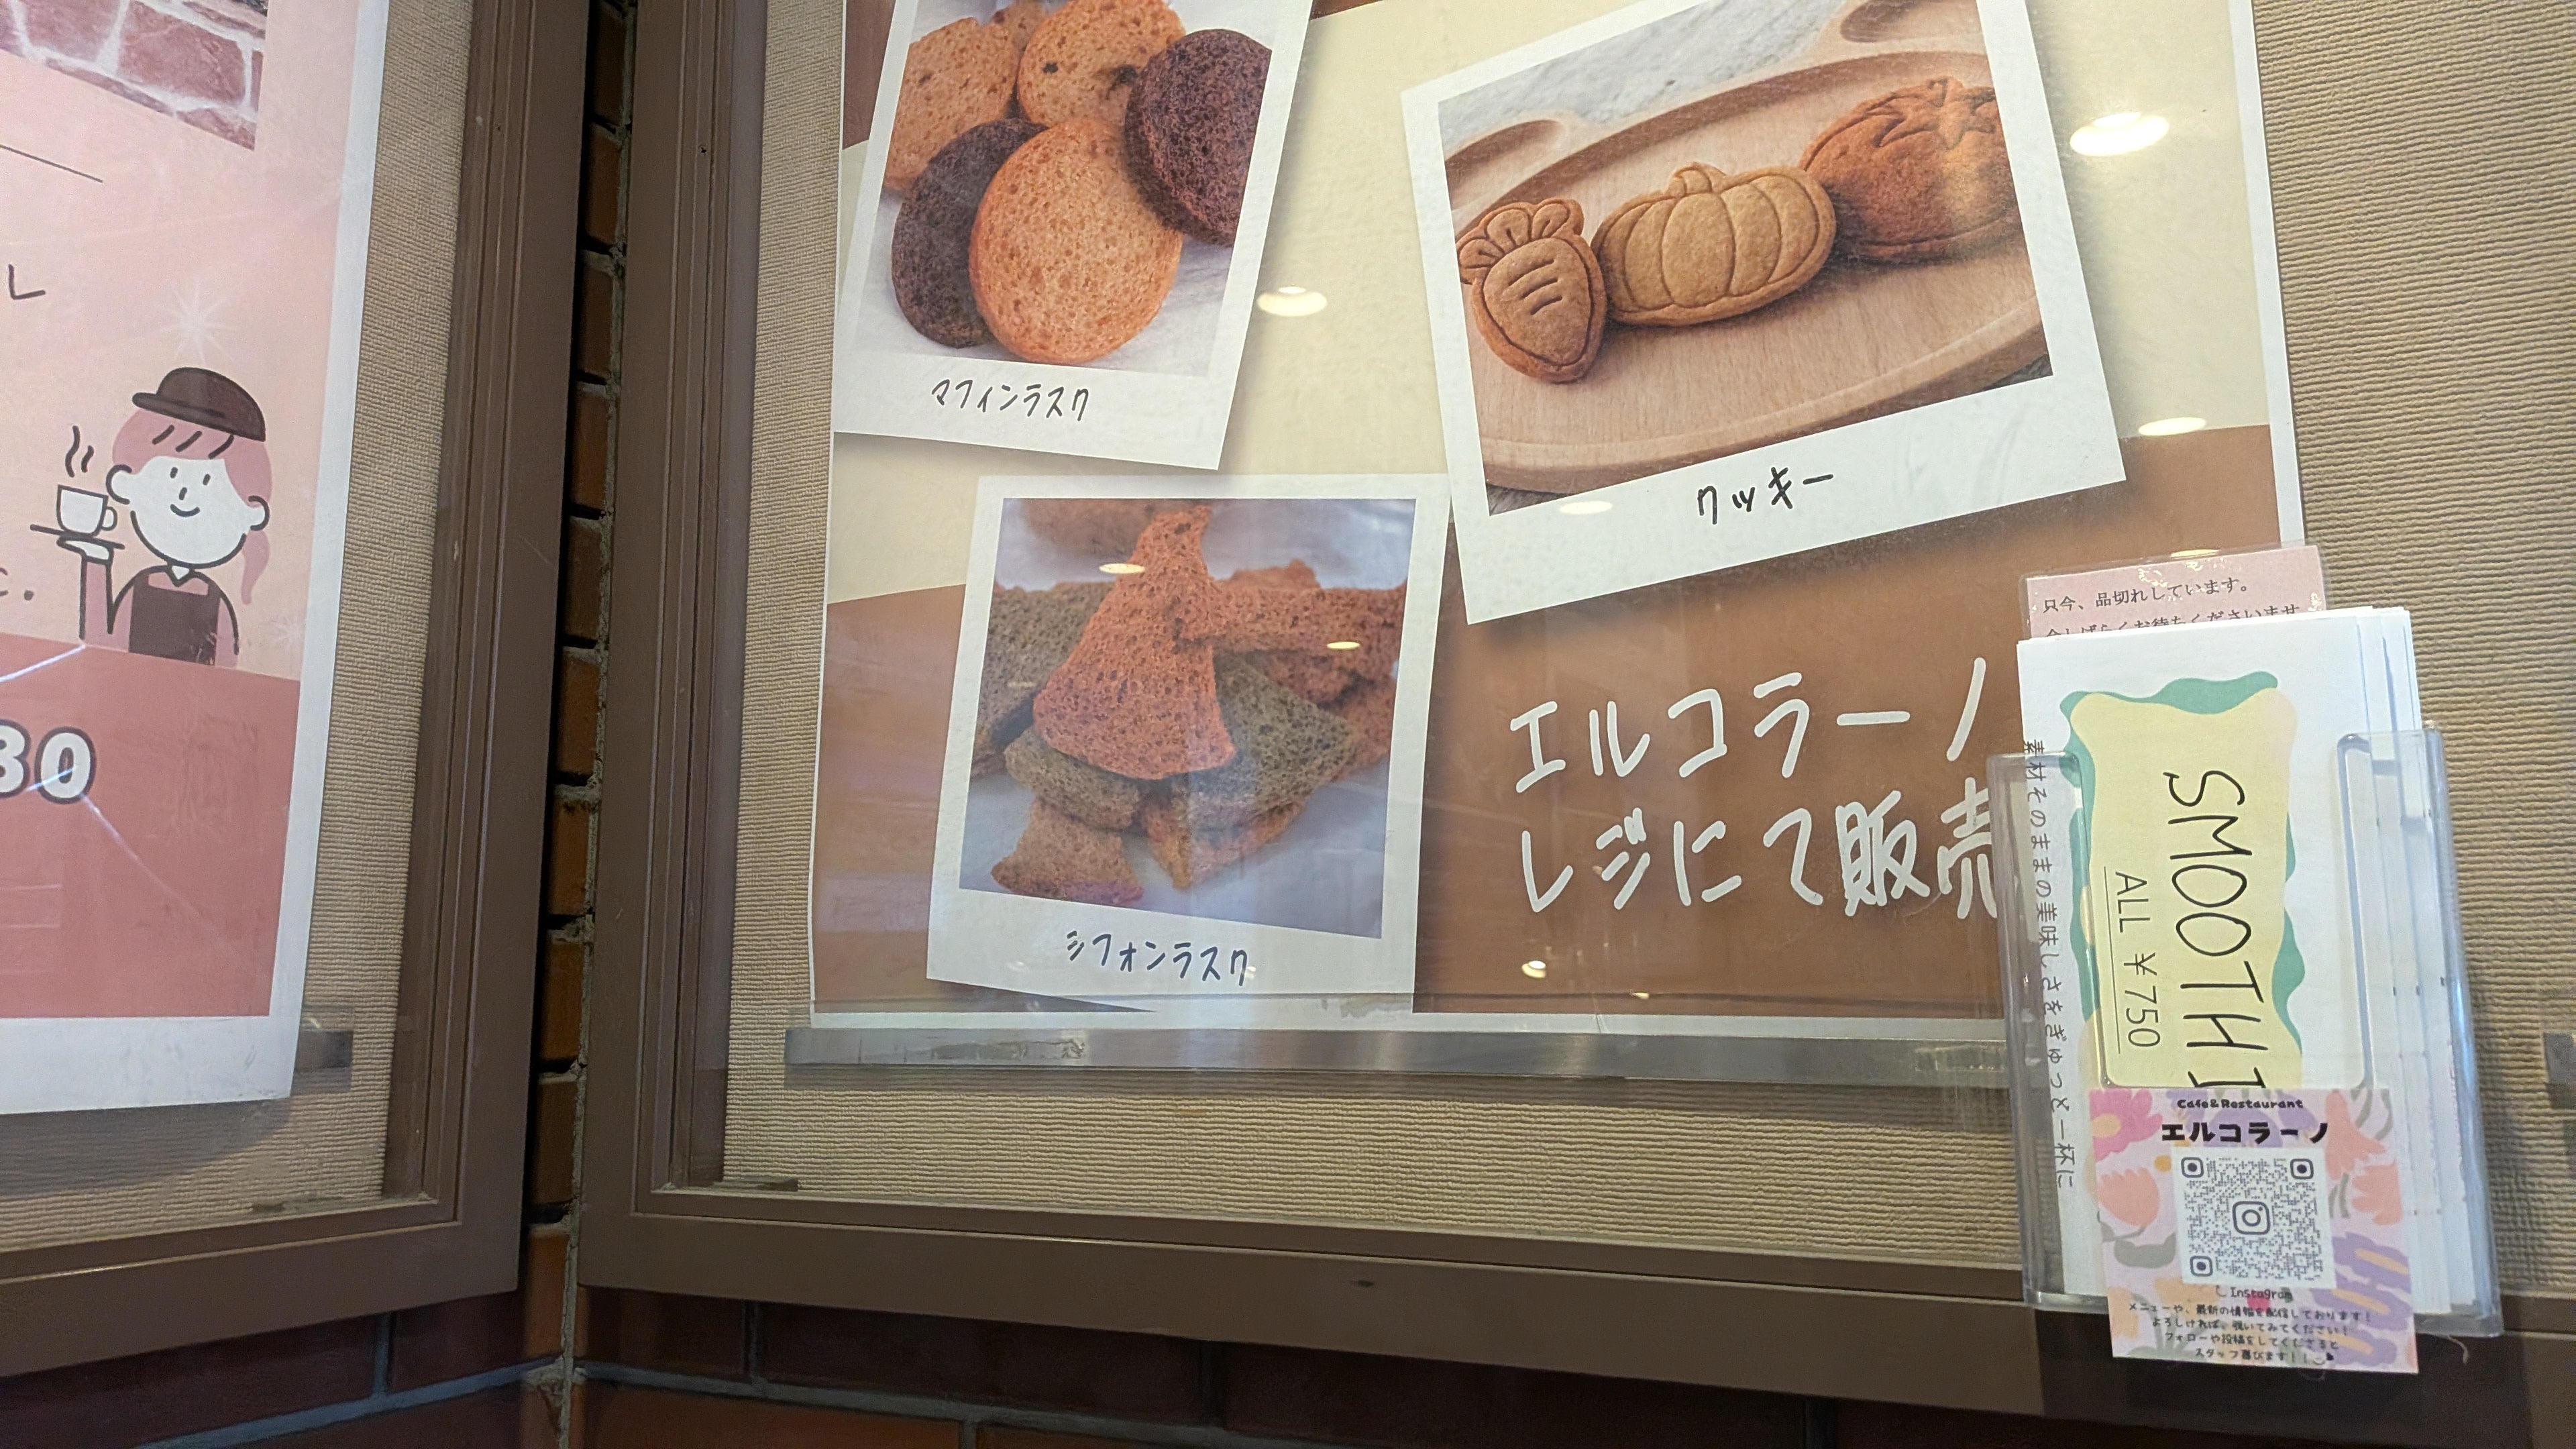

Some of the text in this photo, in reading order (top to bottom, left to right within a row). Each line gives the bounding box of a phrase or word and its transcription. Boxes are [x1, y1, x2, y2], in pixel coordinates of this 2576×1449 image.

[931, 379, 1089, 421] マフィンラスク
[1697, 466, 1834, 525] クッキー
[2043, 576, 2247, 614] 只今、品切れしています。
[1510, 657, 1987, 793] エルコラーノ
[1521, 777, 1999, 920] レジにて販売
[1067, 930, 1248, 986] シフォンラスク
[2114, 871, 2161, 1048] ALL ¥750
[2161, 1122, 2328, 1144] エルコラーノ
[2230, 1287, 2293, 1301] Instagram
